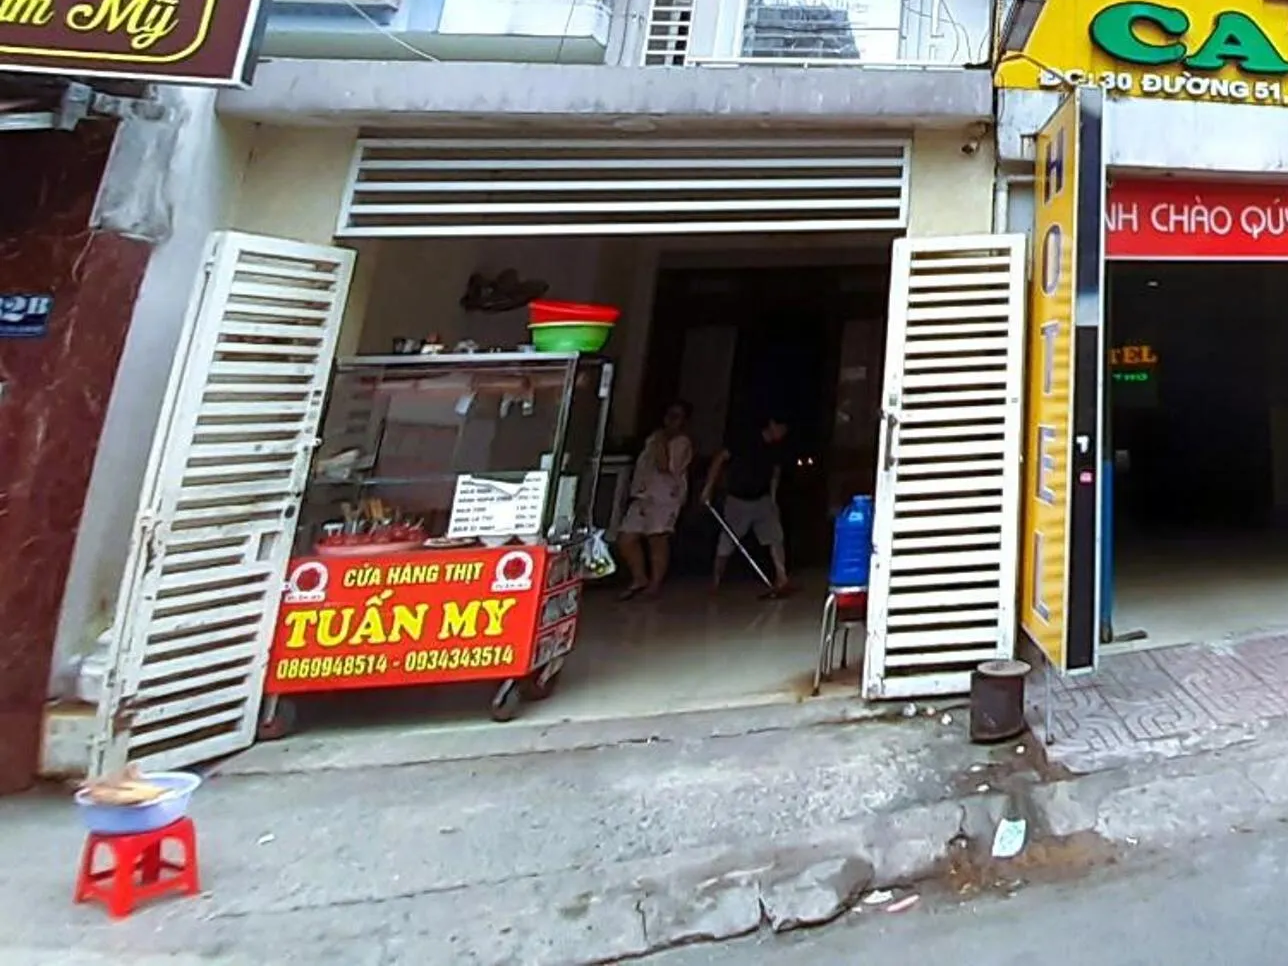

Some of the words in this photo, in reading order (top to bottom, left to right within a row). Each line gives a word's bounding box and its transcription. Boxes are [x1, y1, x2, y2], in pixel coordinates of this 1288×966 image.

[1141, 70, 1250, 99] ĐƯỜNG
[1151, 195, 1232, 234] CHÀO
[1032, 128, 1065, 623] HOTEL
[343, 563, 381, 587] CỬA
[387, 560, 440, 586] HÀNG
[444, 561, 484, 584] THỊT
[284, 589, 429, 648] TUẤN
[438, 597, 517, 640] MY
[276, 654, 388, 680] 0869948514
[404, 644, 514, 672] 0934343514
